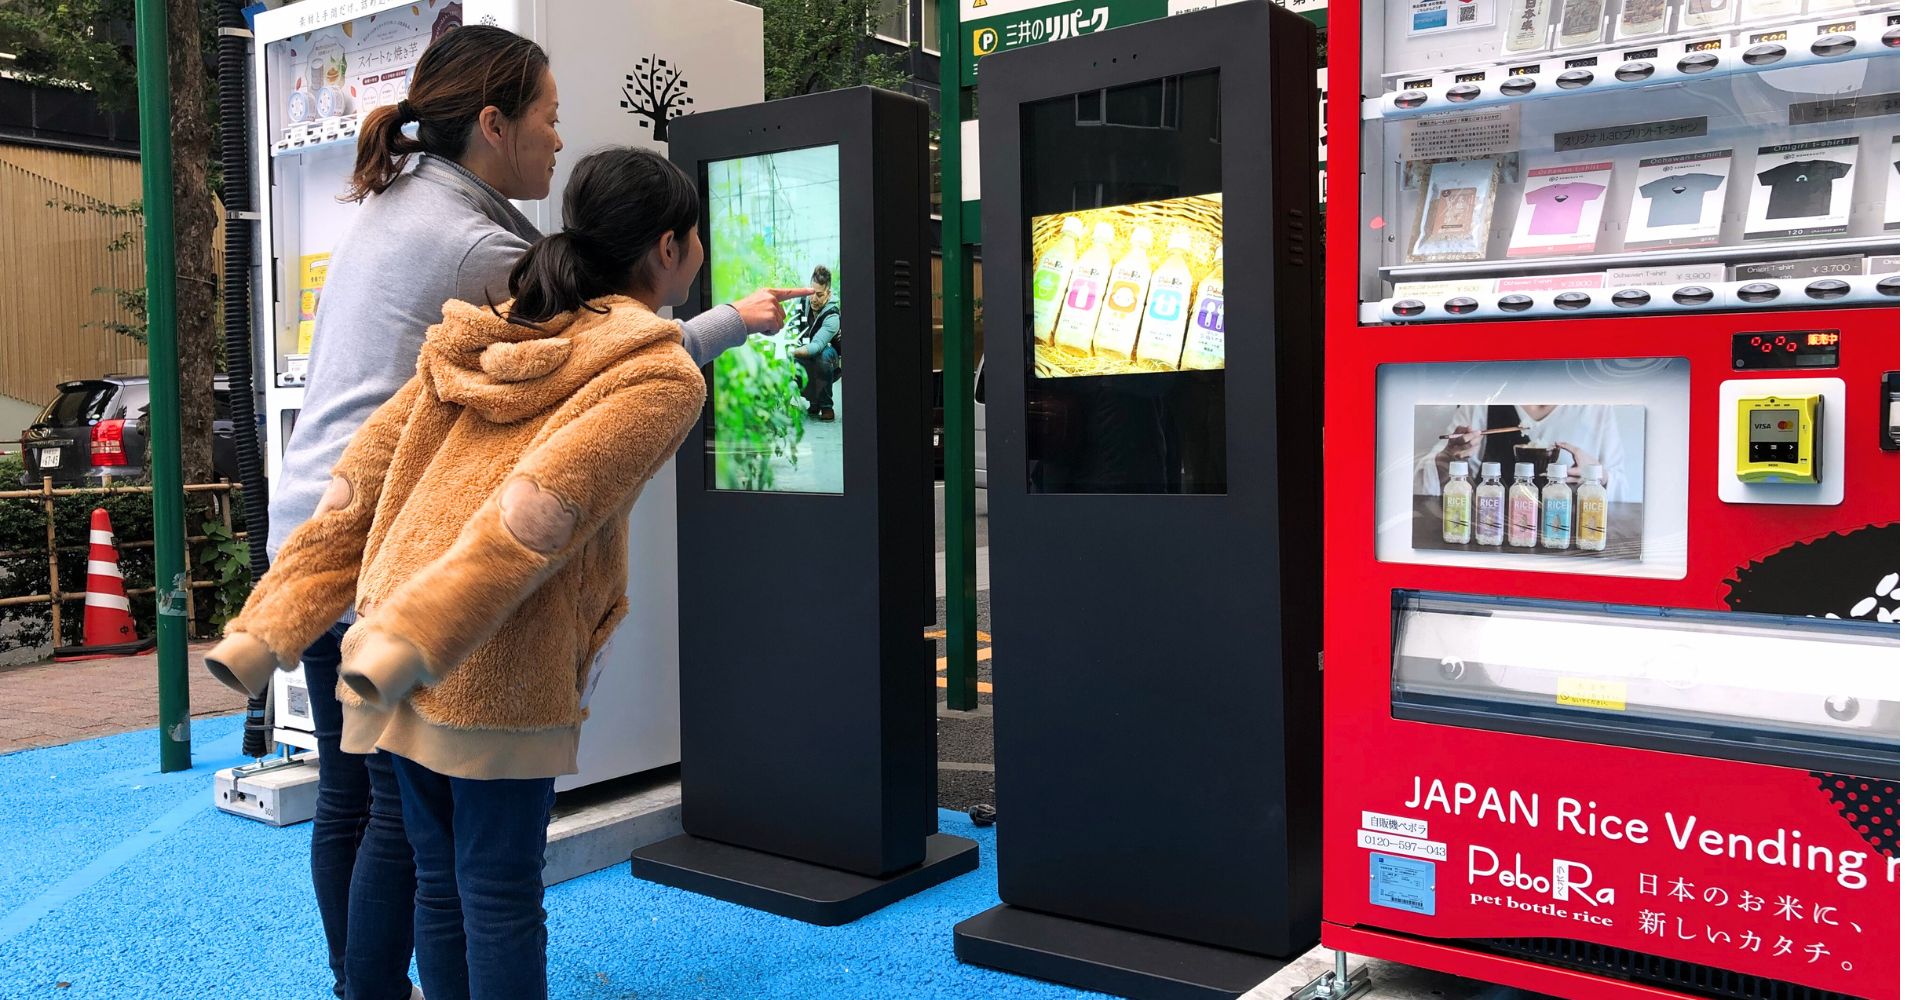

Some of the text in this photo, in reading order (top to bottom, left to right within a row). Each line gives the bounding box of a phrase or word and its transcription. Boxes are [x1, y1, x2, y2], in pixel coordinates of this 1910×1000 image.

[1006, 6, 1109, 46] 三井のリパーク
[358, 41, 418, 68] スイートな焼き芋
[1773, 139, 1845, 152] Onigiri t-shirt
[1650, 151, 1722, 165] Ochawan t-shirt
[1807, 333, 1839, 346] 販売中
[1447, 496, 1467, 505] RICE
[1480, 498, 1499, 507] RICE
[1515, 500, 1533, 509] RICE
[1547, 500, 1567, 509] RICE
[1583, 502, 1603, 511] RICE
[1405, 775, 1538, 828] JAPAN
[1557, 797, 1649, 844] Rice
[1664, 811, 1868, 890] Vending
[1469, 844, 1615, 906] PeboRa
[1470, 892, 1614, 927] pet bottle rice
[1639, 872, 1862, 934] 日本のお米に、
[1638, 908, 1853, 971] 新しいカタチ。
